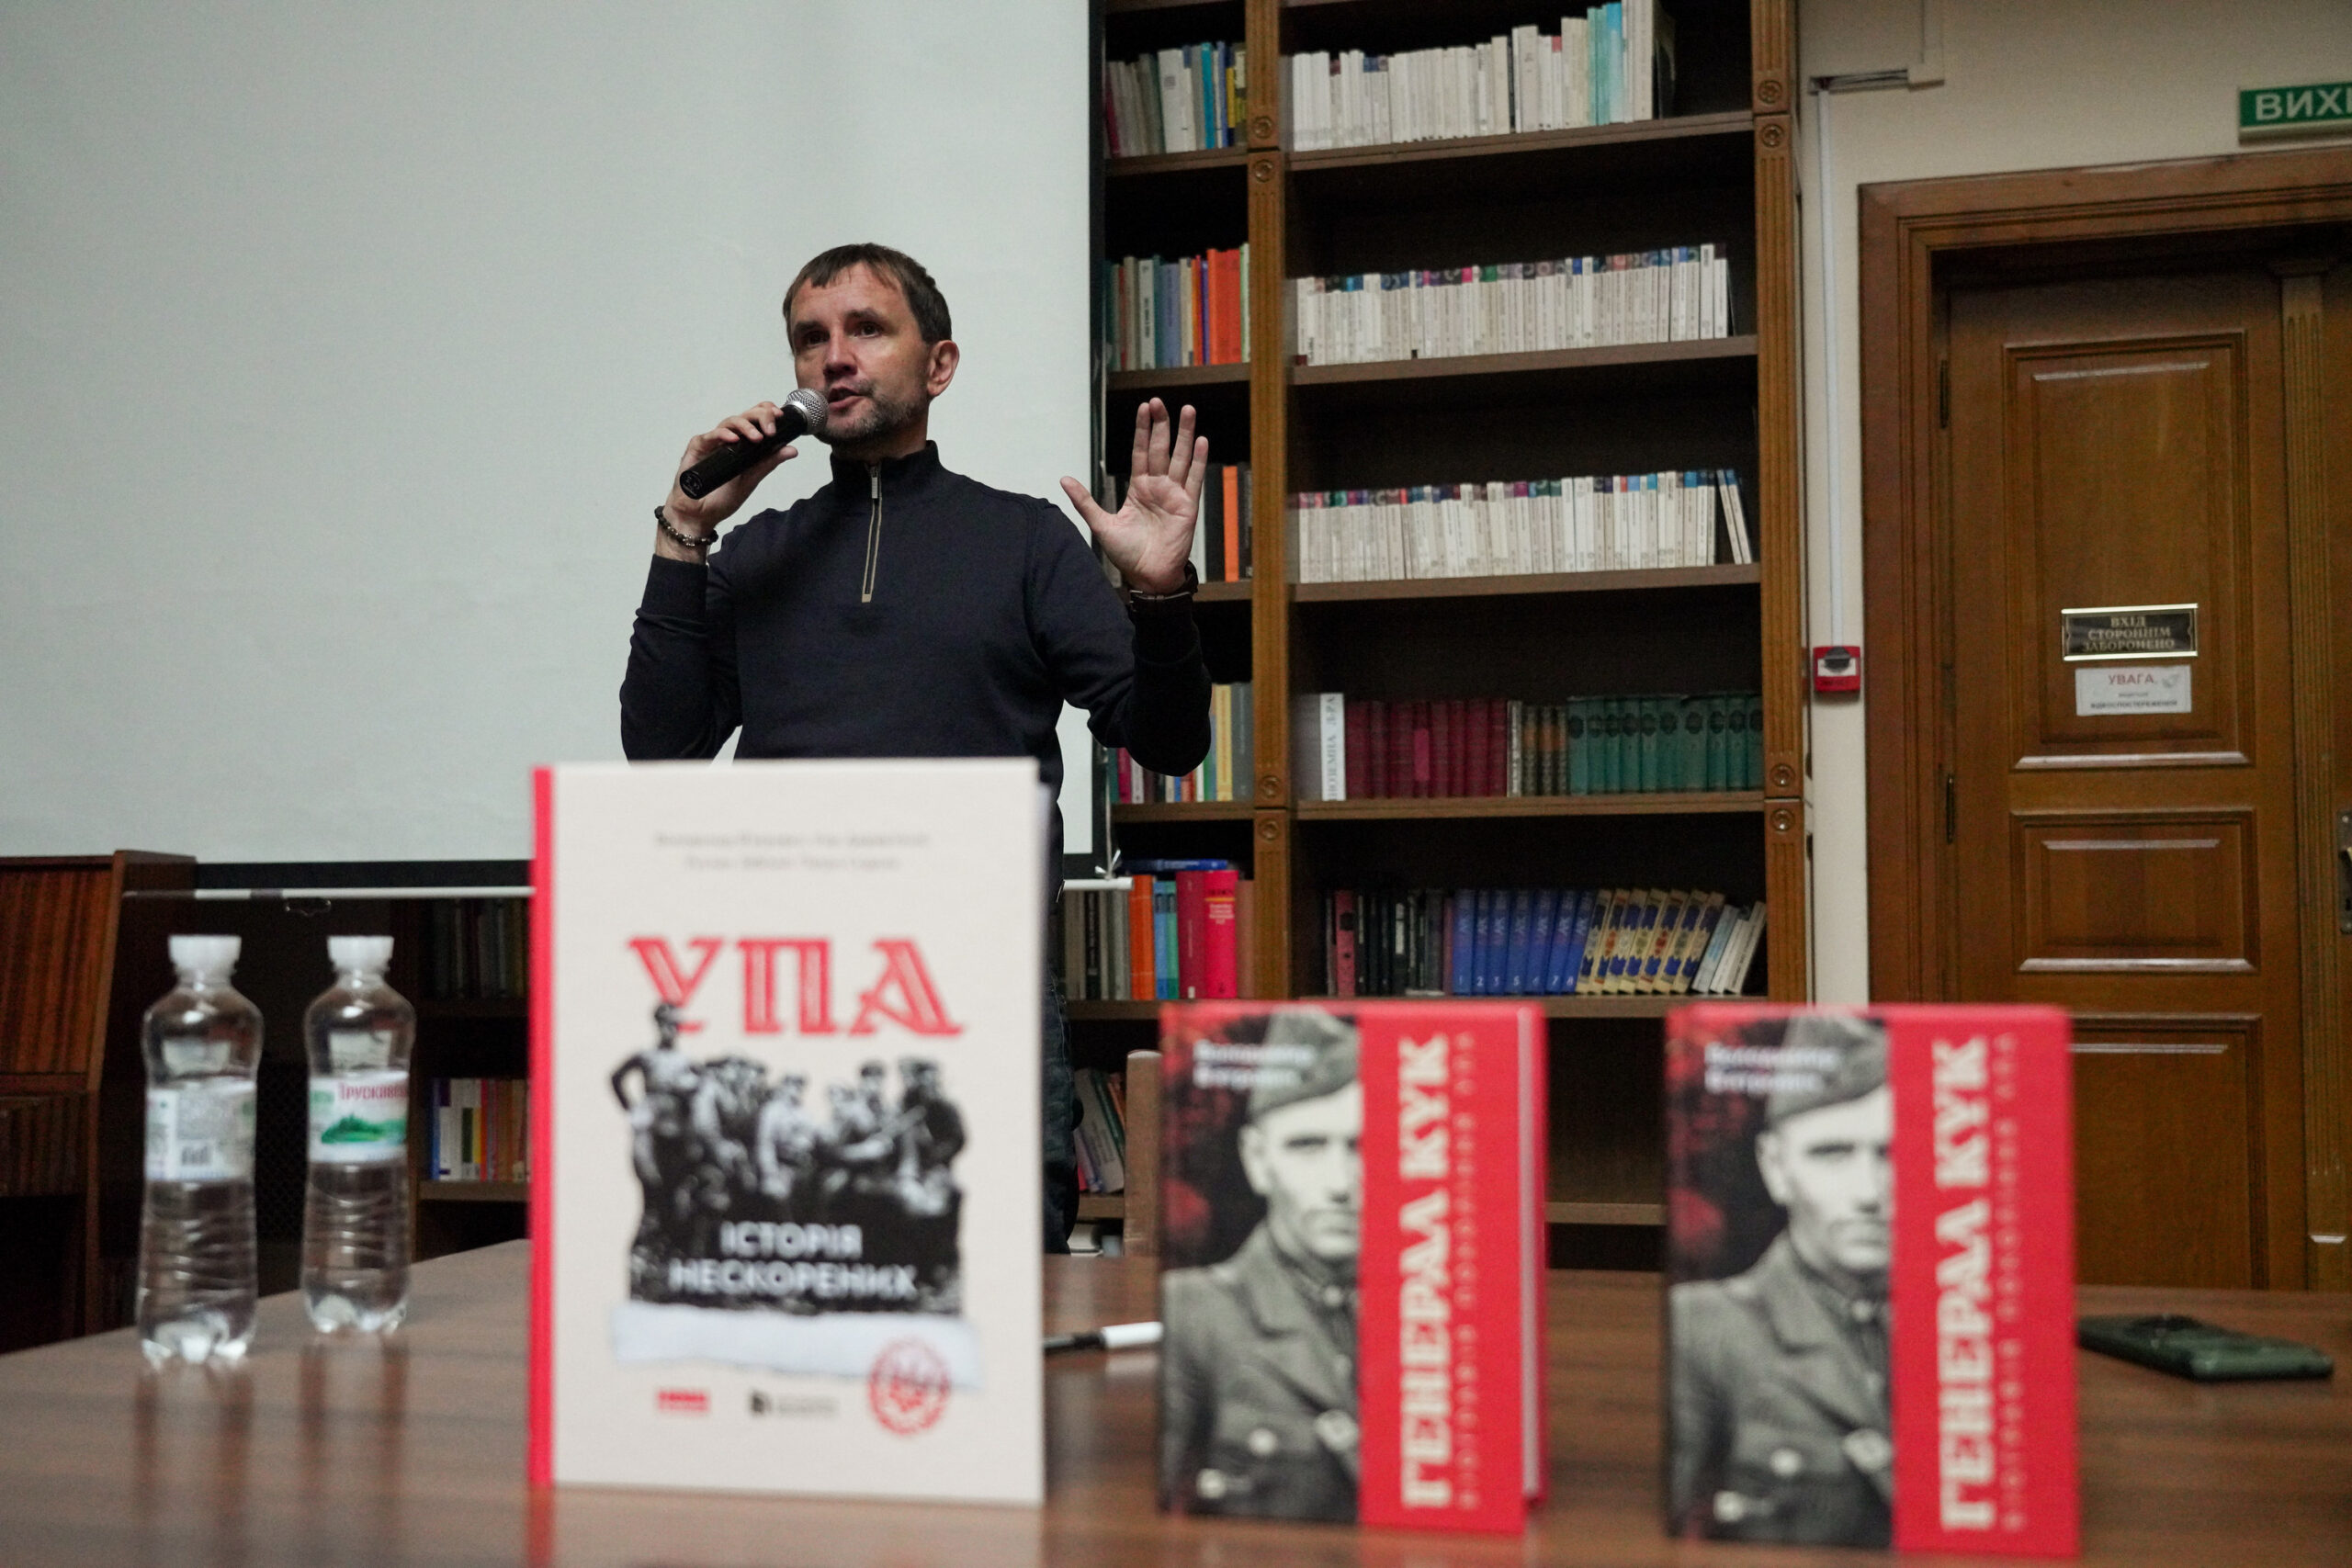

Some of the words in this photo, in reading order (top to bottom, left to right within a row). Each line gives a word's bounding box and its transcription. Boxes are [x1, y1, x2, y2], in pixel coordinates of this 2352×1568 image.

[2088, 626, 2171, 640] СТОРОННІМ
[2110, 615, 2146, 627] ВХІД
[2083, 638, 2175, 652] ЗАБОРОНЕНО
[2109, 673, 2154, 685] УВАГА
[628, 936, 963, 1035] УПА
[1396, 1032, 1451, 1181] КУК
[1931, 1035, 1992, 1190] КУК
[719, 1220, 864, 1260] ІСТОРІЯ
[668, 1257, 918, 1301] НЕСКОРЕНИХ
[1398, 1189, 1453, 1509] ГЕНЕРАЛ
[1935, 1196, 1997, 1533] ГЕНЕРАЛ
